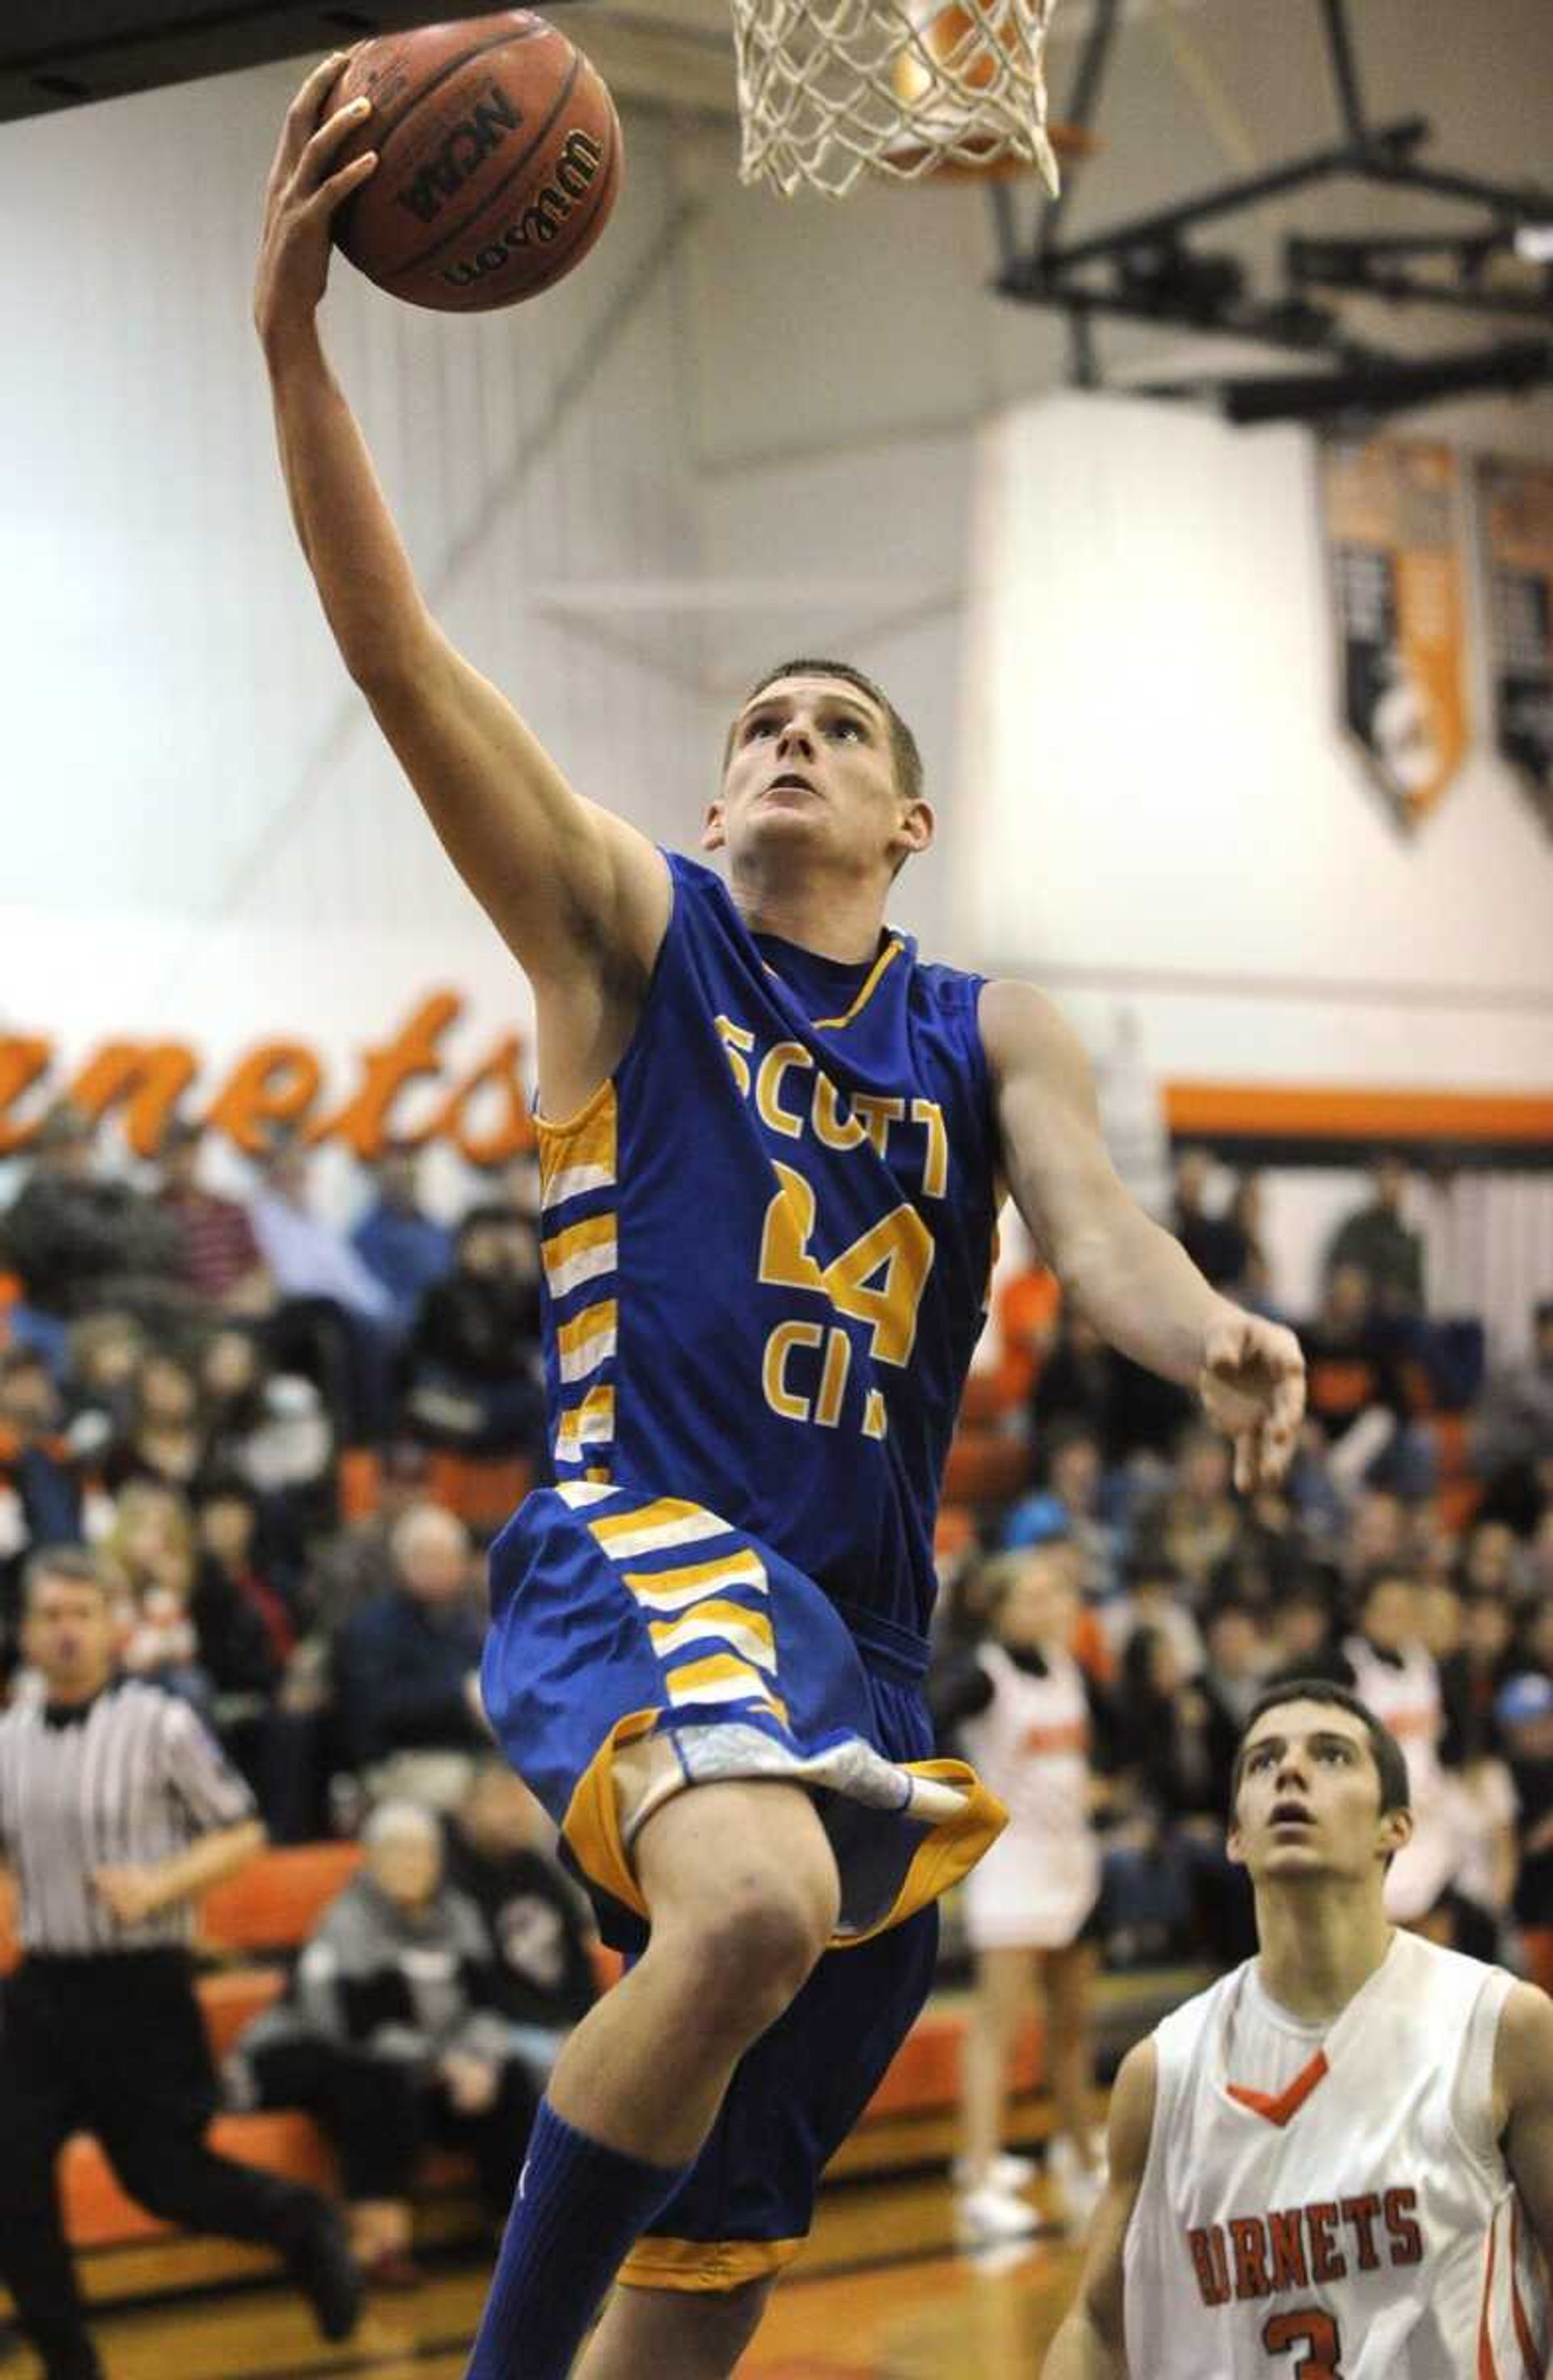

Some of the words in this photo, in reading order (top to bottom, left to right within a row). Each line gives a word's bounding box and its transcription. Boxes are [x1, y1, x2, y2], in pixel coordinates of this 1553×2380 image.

[396, 78, 523, 225] NCAA
[441, 127, 603, 287] Wilson
[757, 1157, 935, 1368] 24
